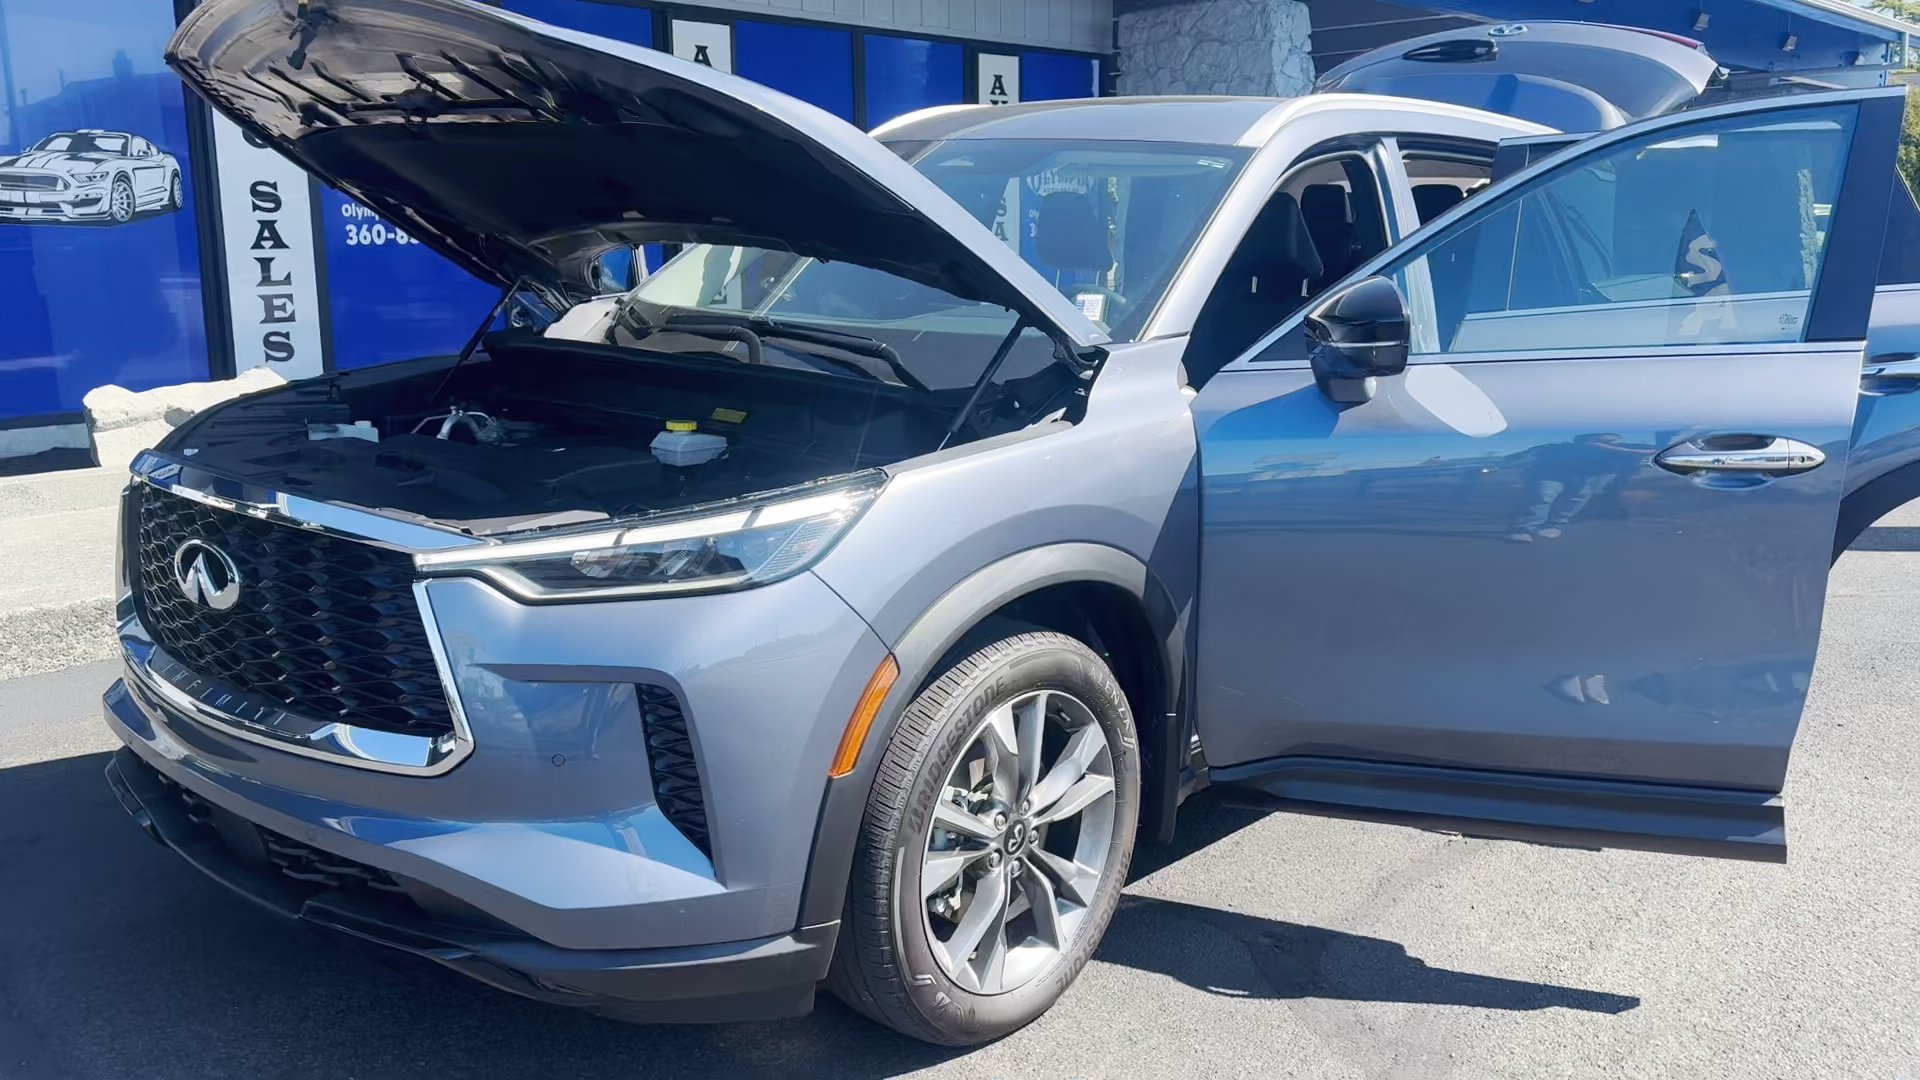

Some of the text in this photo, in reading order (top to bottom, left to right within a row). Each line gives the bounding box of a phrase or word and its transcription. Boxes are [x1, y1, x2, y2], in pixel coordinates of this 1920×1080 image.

[989, 74, 1009, 106] A
[249, 180, 297, 364] SALES
[345, 223, 420, 246] 360-8
[909, 675, 1006, 836] BRIDGESTONE
